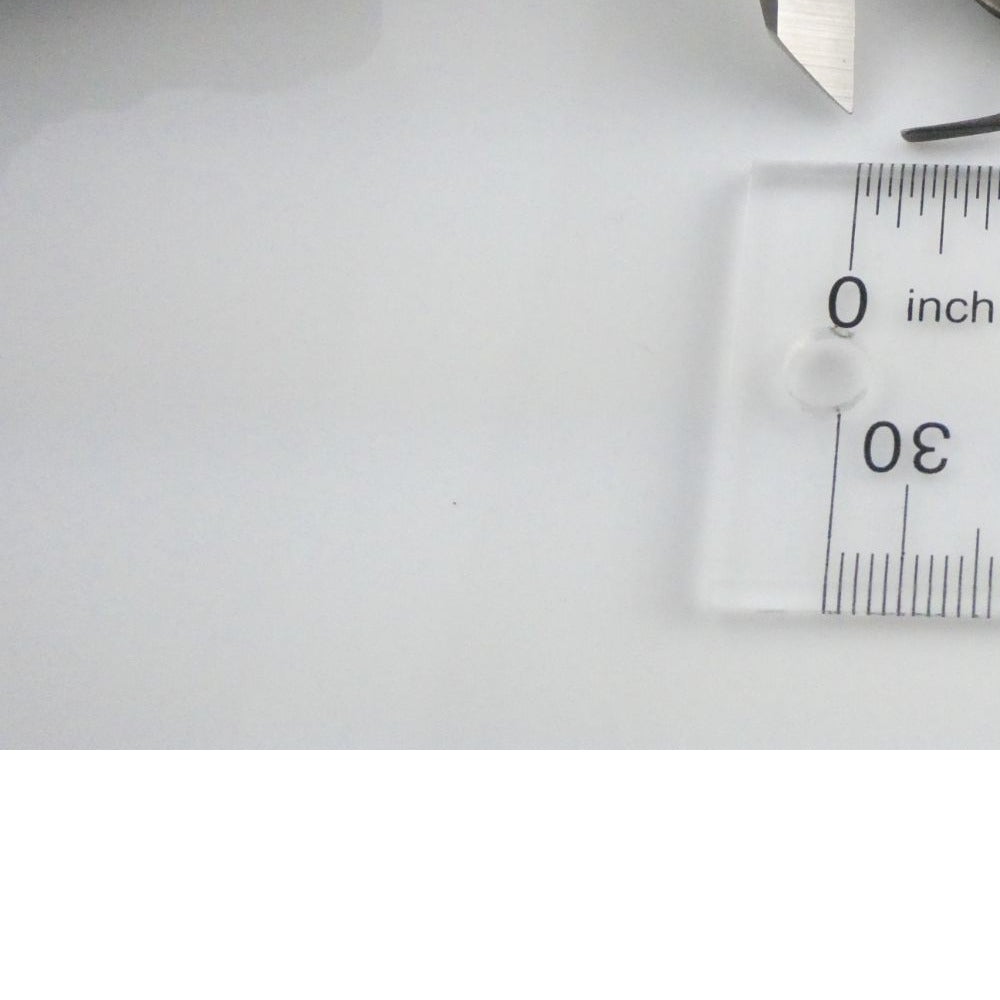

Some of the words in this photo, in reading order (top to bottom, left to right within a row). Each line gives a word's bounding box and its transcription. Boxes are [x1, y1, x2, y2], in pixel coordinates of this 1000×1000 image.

[828, 275, 868, 328] 0
[907, 288, 994, 324] inch
[863, 420, 951, 475] 30
